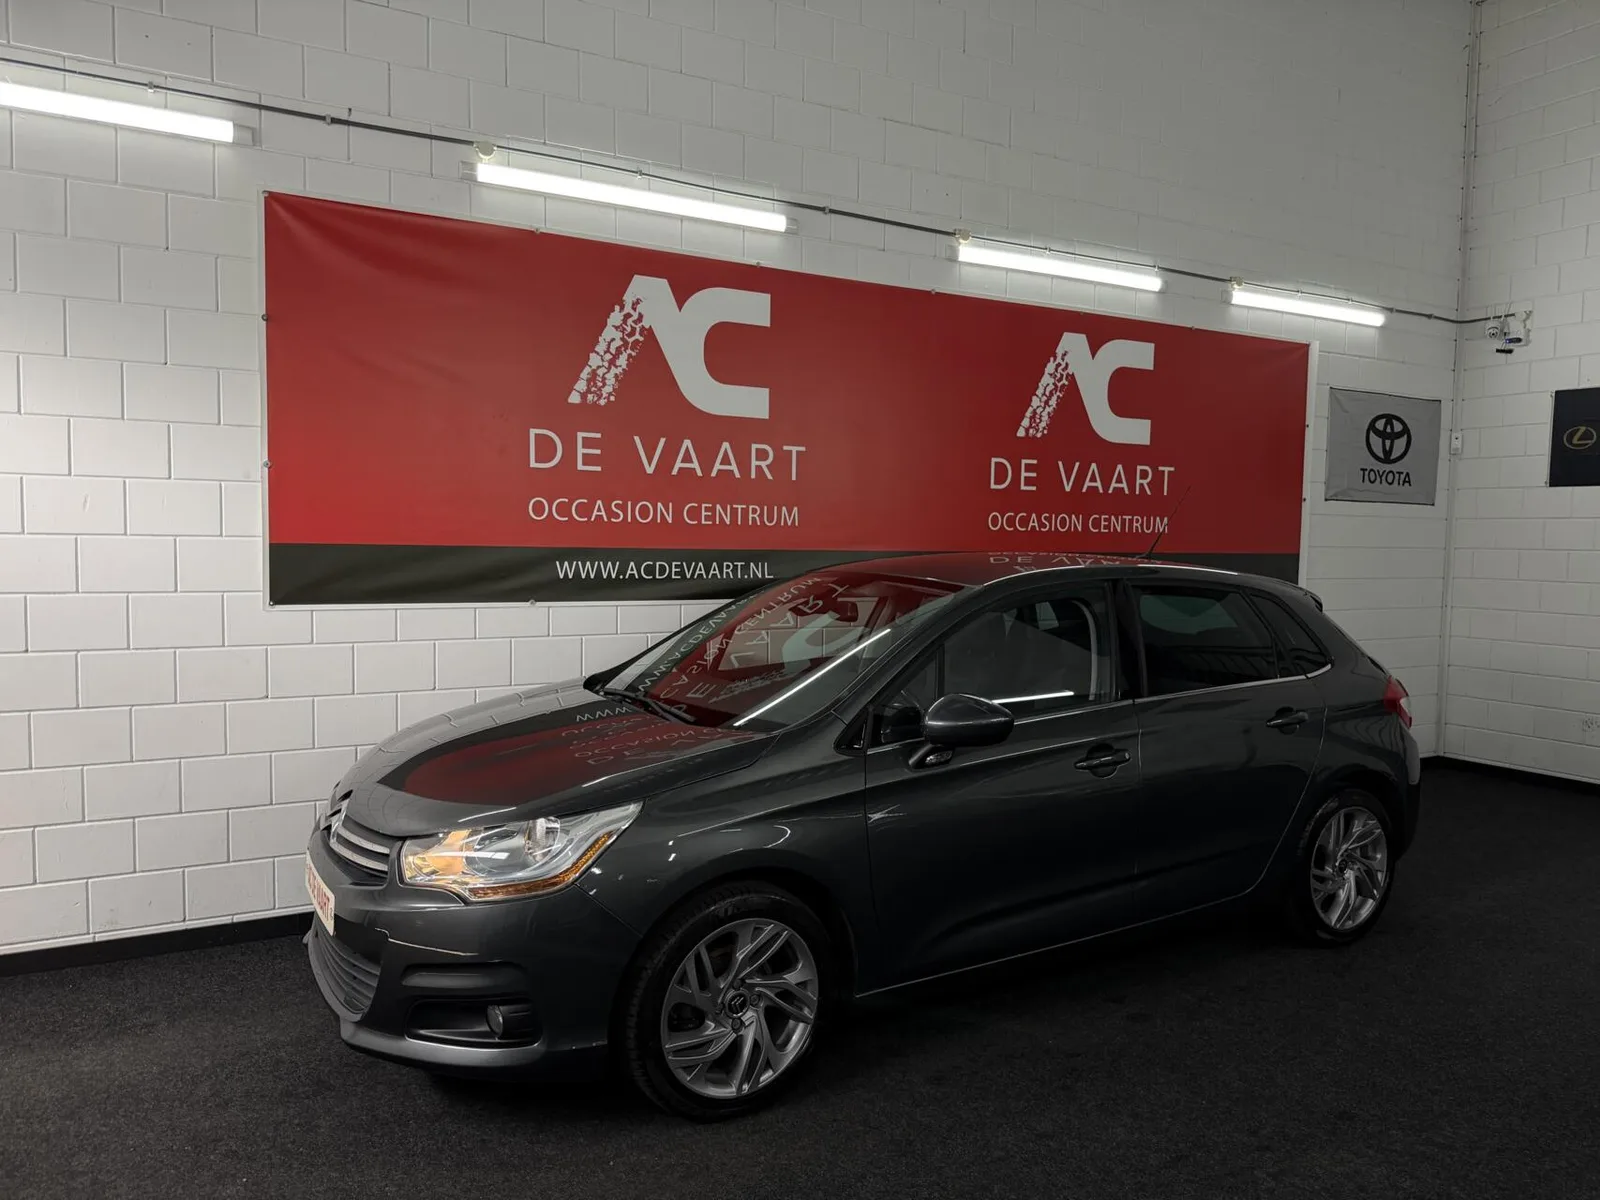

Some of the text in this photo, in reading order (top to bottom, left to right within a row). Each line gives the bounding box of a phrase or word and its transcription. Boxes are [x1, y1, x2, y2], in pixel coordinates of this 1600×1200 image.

[568, 275, 770, 419] AC
[1017, 332, 1154, 445] AC
[530, 429, 805, 480] DE VAART
[991, 458, 1174, 495] DE VAART
[1360, 468, 1411, 486] TOYOTA
[529, 498, 798, 525] OCCASION CENTRUM
[989, 512, 1167, 533] OCCASION CENTRUM
[556, 561, 773, 578] WWW.ACDEVAART.NL
